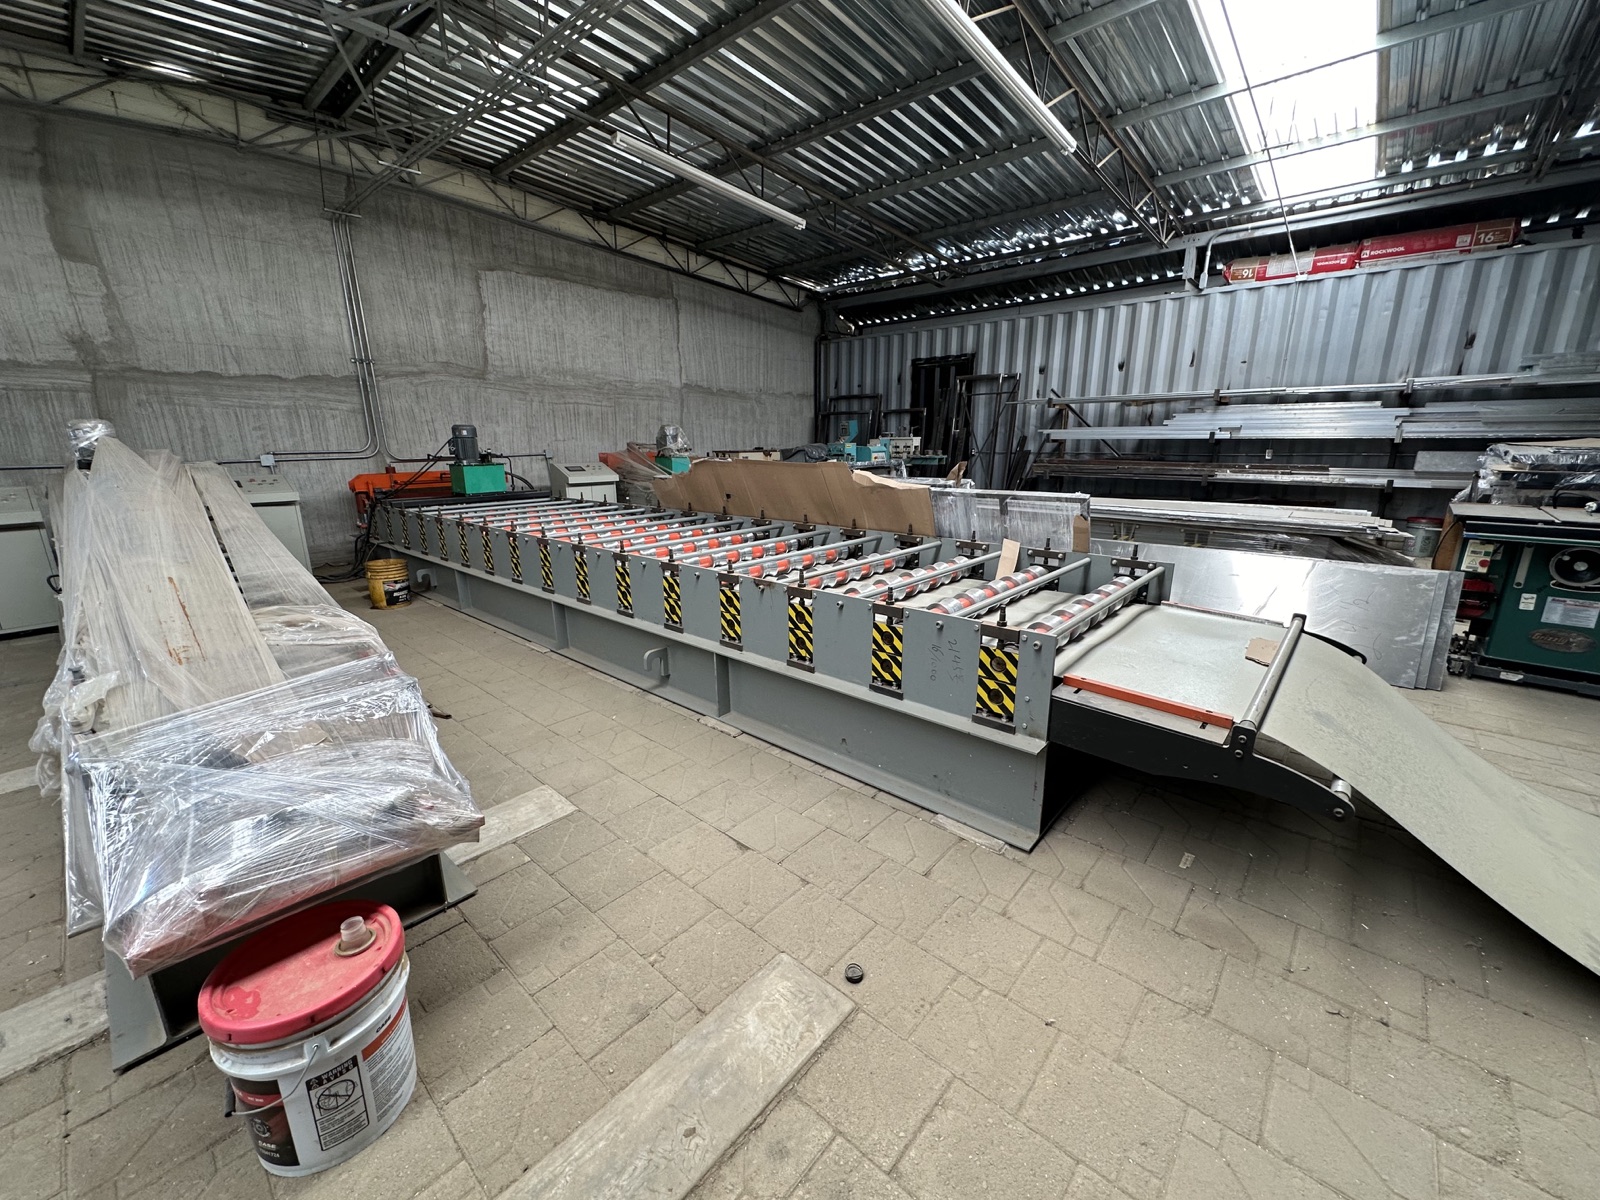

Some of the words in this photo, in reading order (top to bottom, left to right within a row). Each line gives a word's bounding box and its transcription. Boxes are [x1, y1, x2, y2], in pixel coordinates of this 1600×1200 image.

[1478, 232, 1494, 244] 16
[1370, 246, 1406, 256] ROCKWOOL
[1242, 268, 1254, 279] 16
[321, 1059, 353, 1079] WARNING
[322, 1064, 354, 1084] AVISO
